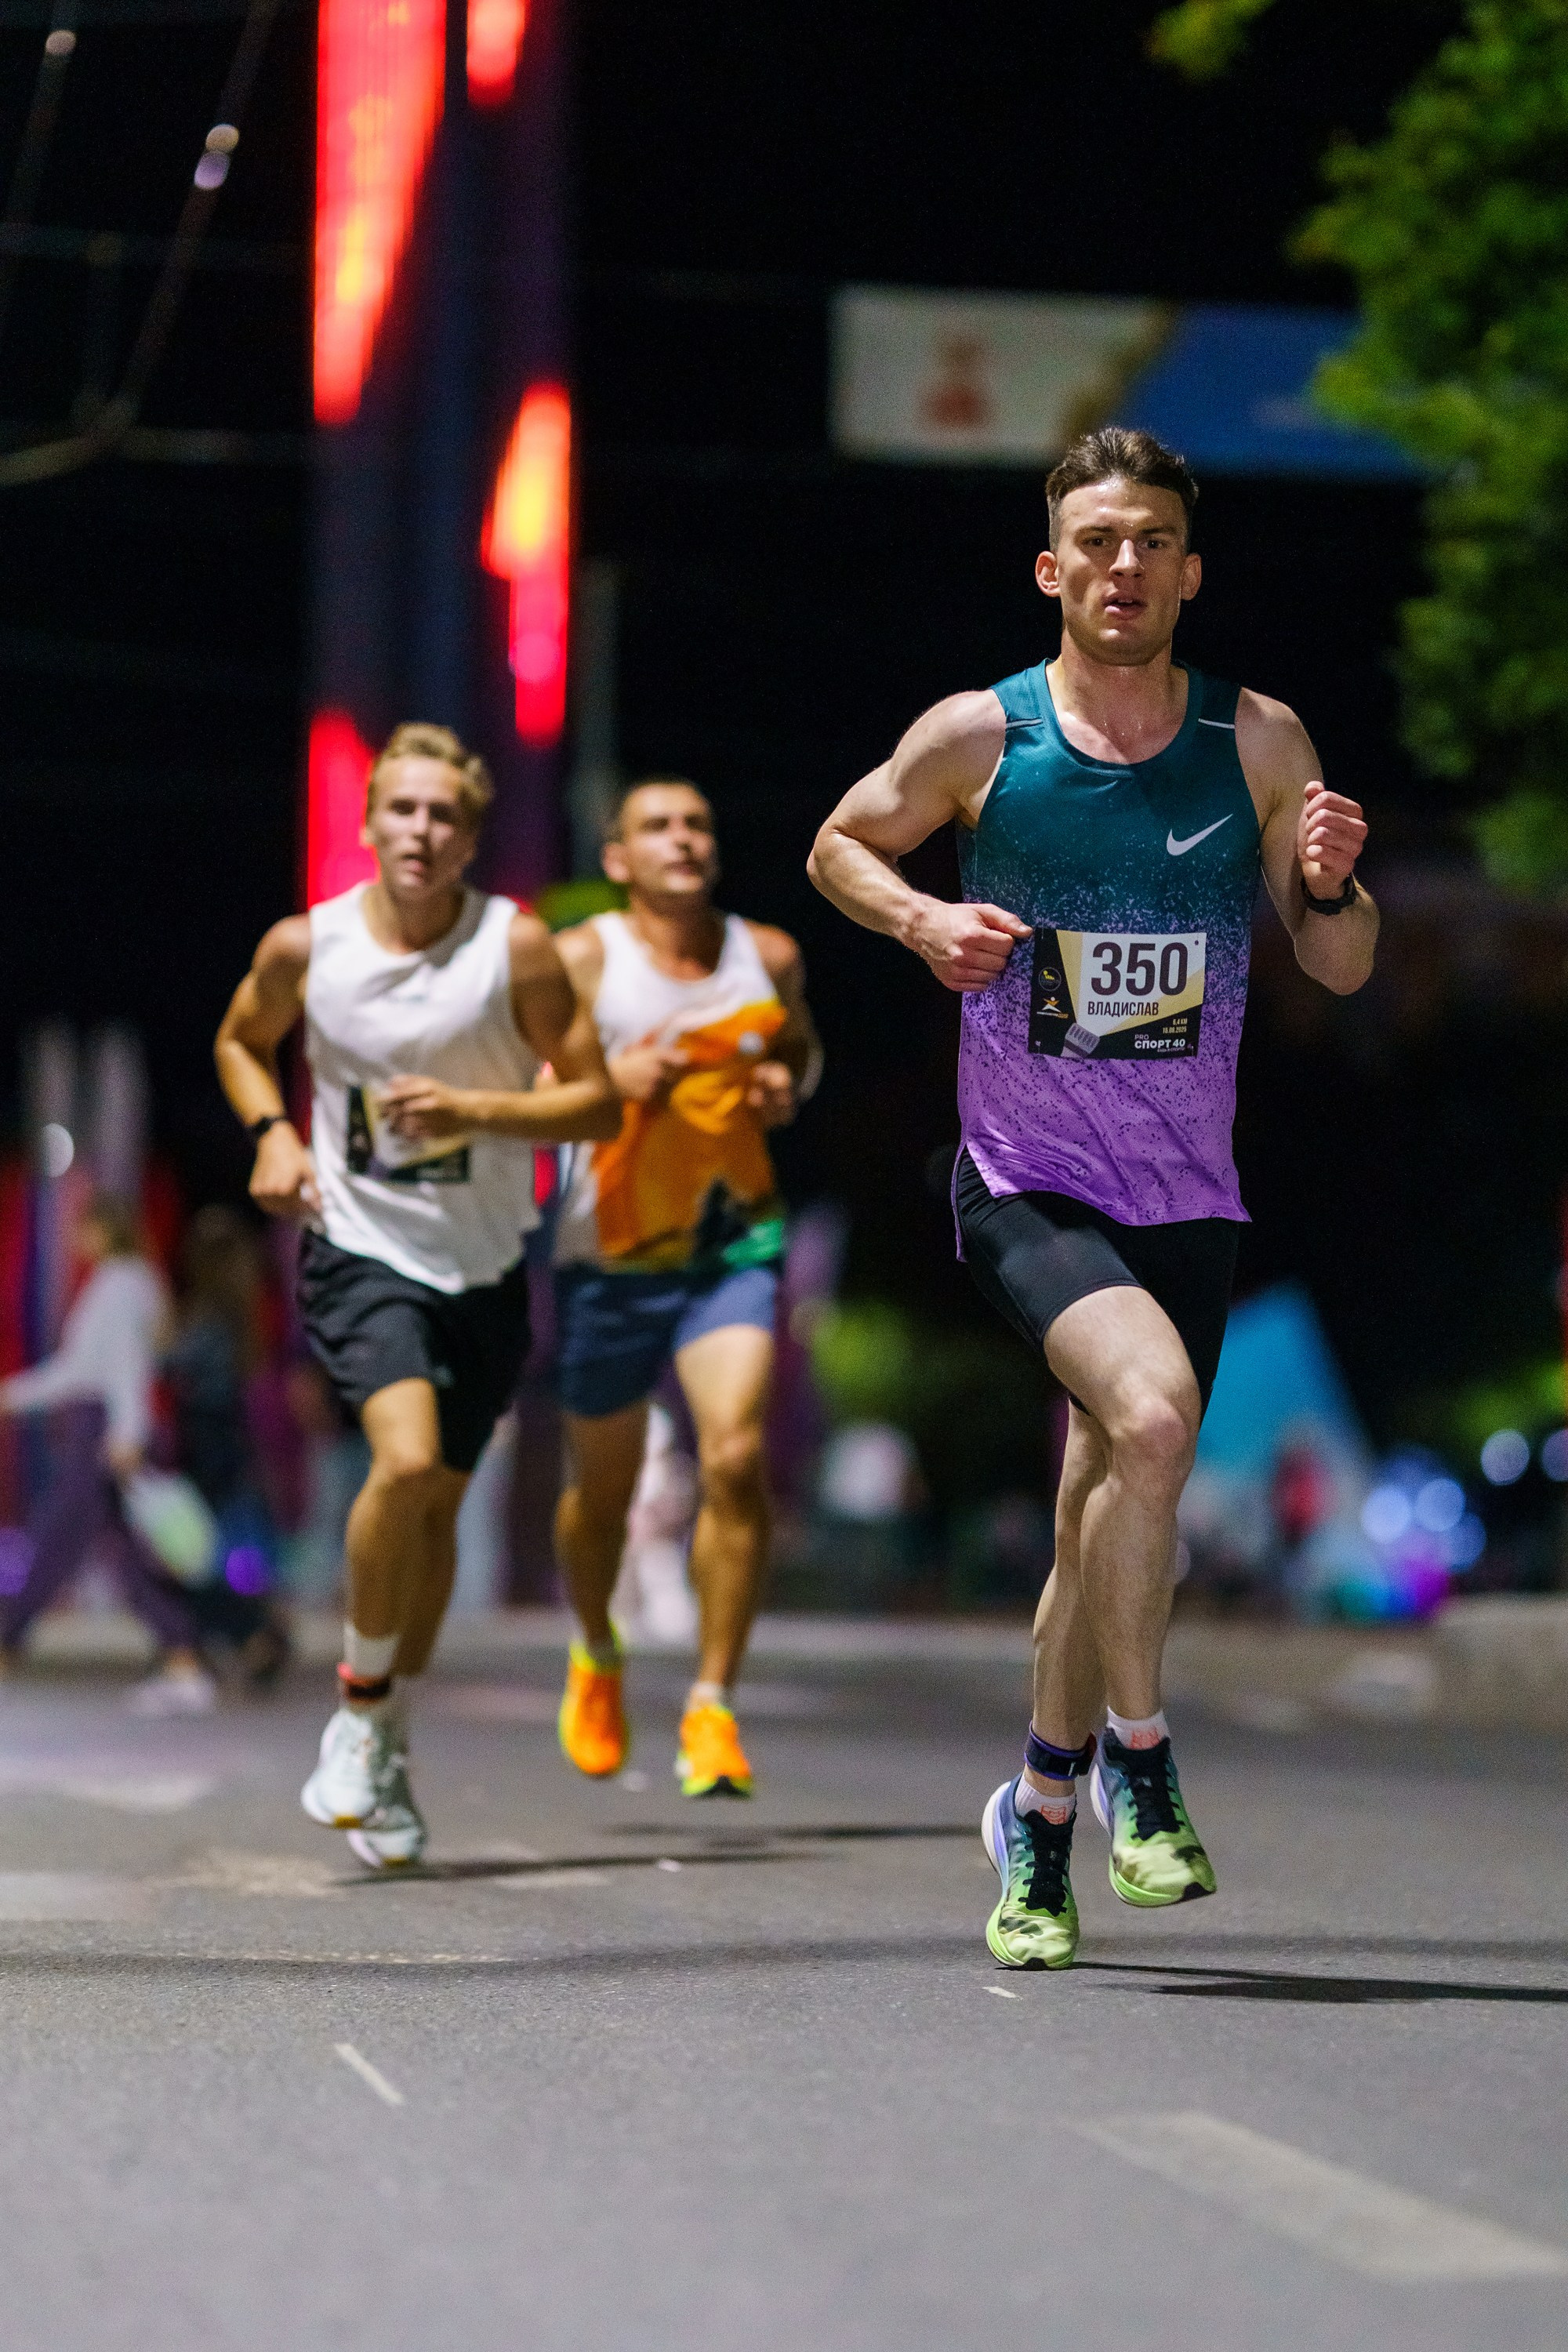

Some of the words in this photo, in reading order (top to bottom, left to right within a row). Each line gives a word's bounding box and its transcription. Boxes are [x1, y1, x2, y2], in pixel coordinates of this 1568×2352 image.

[1091, 942, 1188, 996] 350
[1087, 1001, 1159, 1017] ВЛАДИСЛАВ
[1134, 1040, 1171, 1049] СПОРТ
[1172, 1038, 1185, 1047] 40
